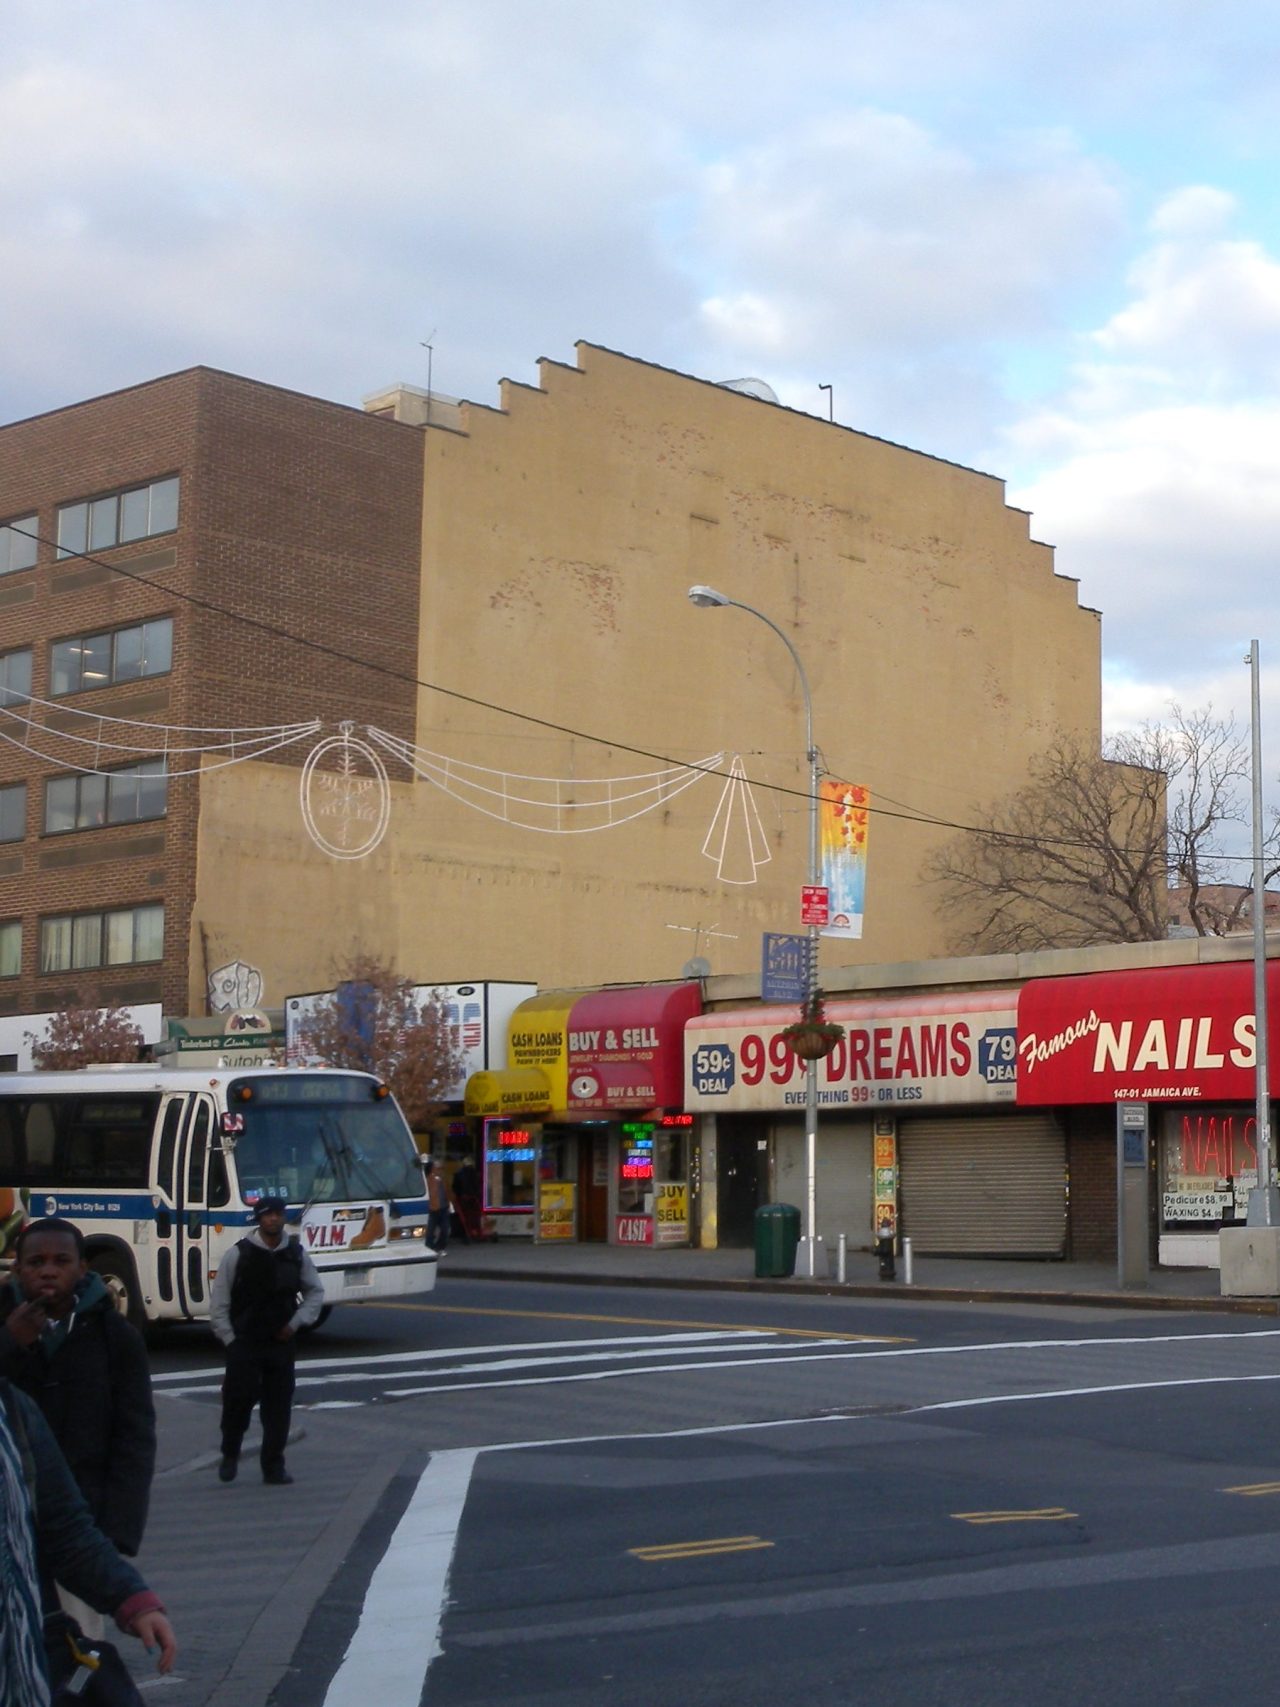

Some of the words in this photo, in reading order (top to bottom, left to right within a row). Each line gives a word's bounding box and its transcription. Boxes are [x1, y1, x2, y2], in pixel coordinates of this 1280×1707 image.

[512, 1032, 533, 1047] CASH
[535, 1031, 562, 1047] LOANS
[568, 1030, 600, 1051] BUY
[605, 1032, 618, 1049] &
[622, 1027, 659, 1049] SELL
[1018, 1009, 1101, 1073] Famous
[1094, 1014, 1257, 1073] NAILS
[826, 1021, 971, 1083] DREAMS
[607, 1086, 625, 1097] BUY
[636, 1085, 656, 1096] SELL
[699, 1078, 728, 1093] DEAL
[1113, 1088, 1140, 1098] 147-01
[1142, 1087, 1179, 1098] JAMAICA
[1181, 1087, 1202, 1097] AVE.
[785, 1090, 849, 1104] EVERTHING
[878, 1088, 893, 1100] OR
[897, 1086, 922, 1100] LESS
[1183, 1115, 1258, 1178] NAILS
[658, 1185, 684, 1198] BUY
[1164, 1195, 1204, 1205] Pedicure
[657, 1208, 686, 1222] SELL
[1164, 1208, 1199, 1217] WAXING
[618, 1218, 648, 1241] CASH
